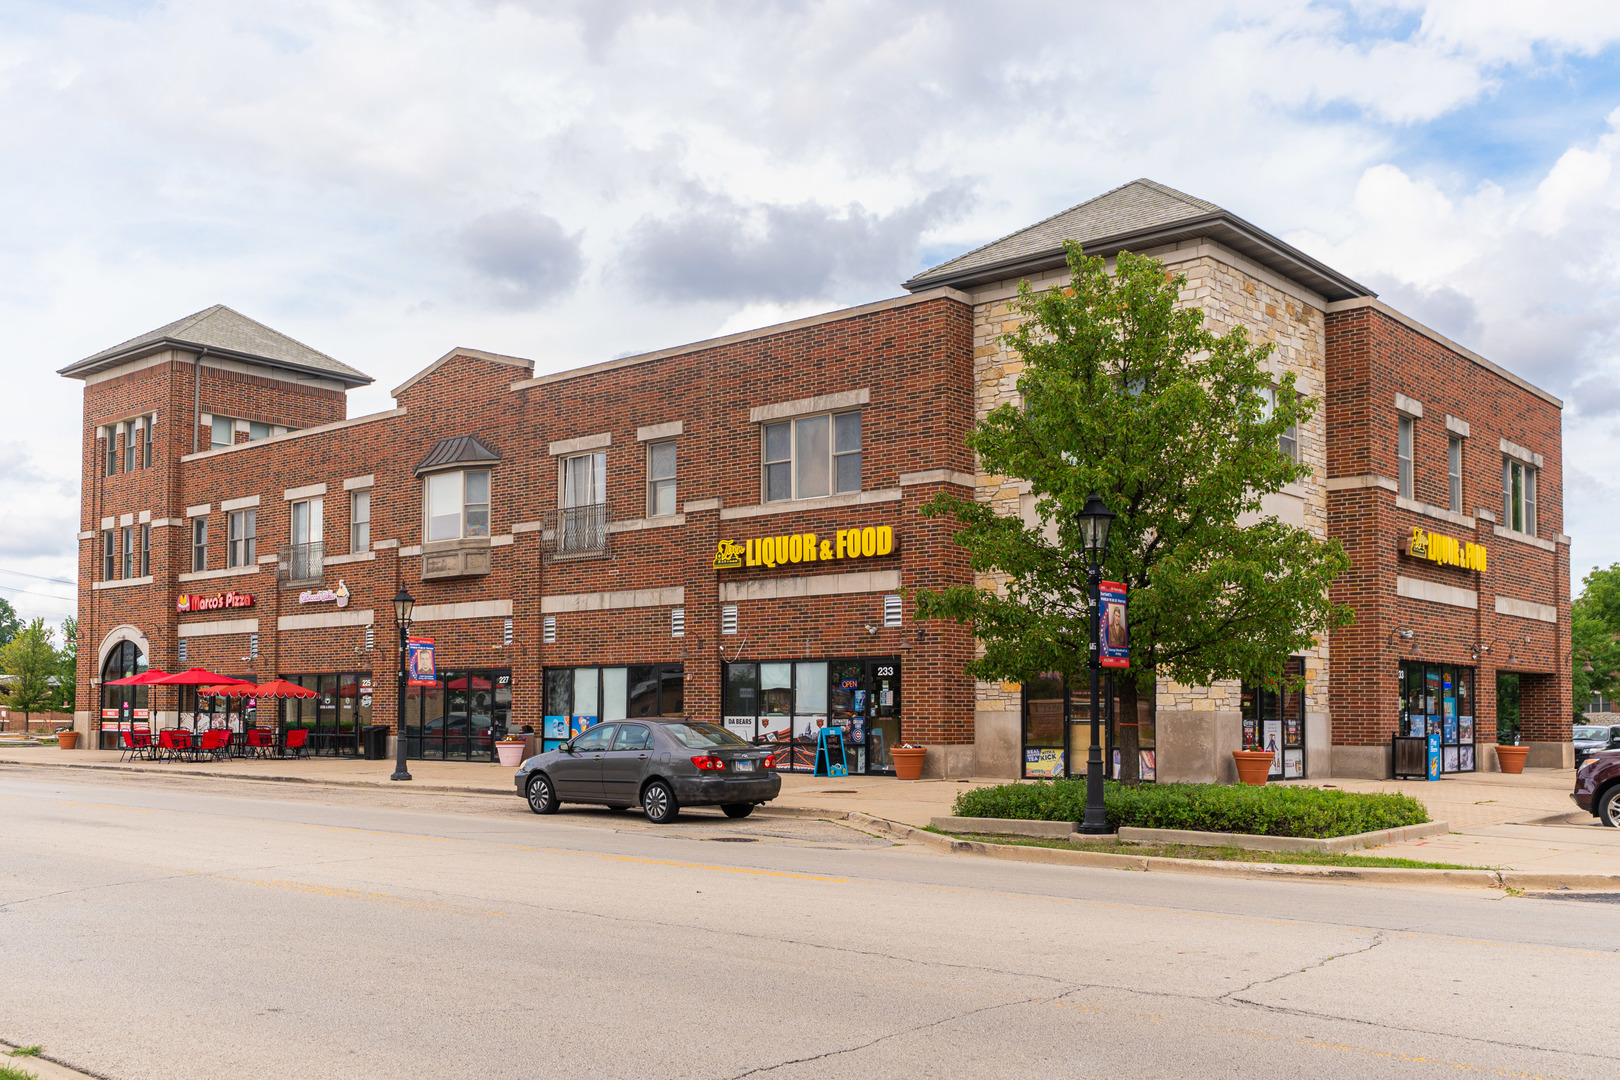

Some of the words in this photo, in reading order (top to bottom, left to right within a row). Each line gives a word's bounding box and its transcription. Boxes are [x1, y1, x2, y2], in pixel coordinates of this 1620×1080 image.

[746, 533, 817, 568] LIQUOR
[820, 539, 833, 561] &
[836, 526, 892, 559] FOOD
[1428, 532, 1460, 566] LIQUOR
[1465, 542, 1487, 572] FOOD
[191, 593, 224, 611] Marco's
[226, 591, 251, 608] Pizza
[877, 666, 894, 676] 233
[362, 679, 372, 687] 225
[499, 676, 510, 684] 227
[842, 680, 858, 689] OPEN
